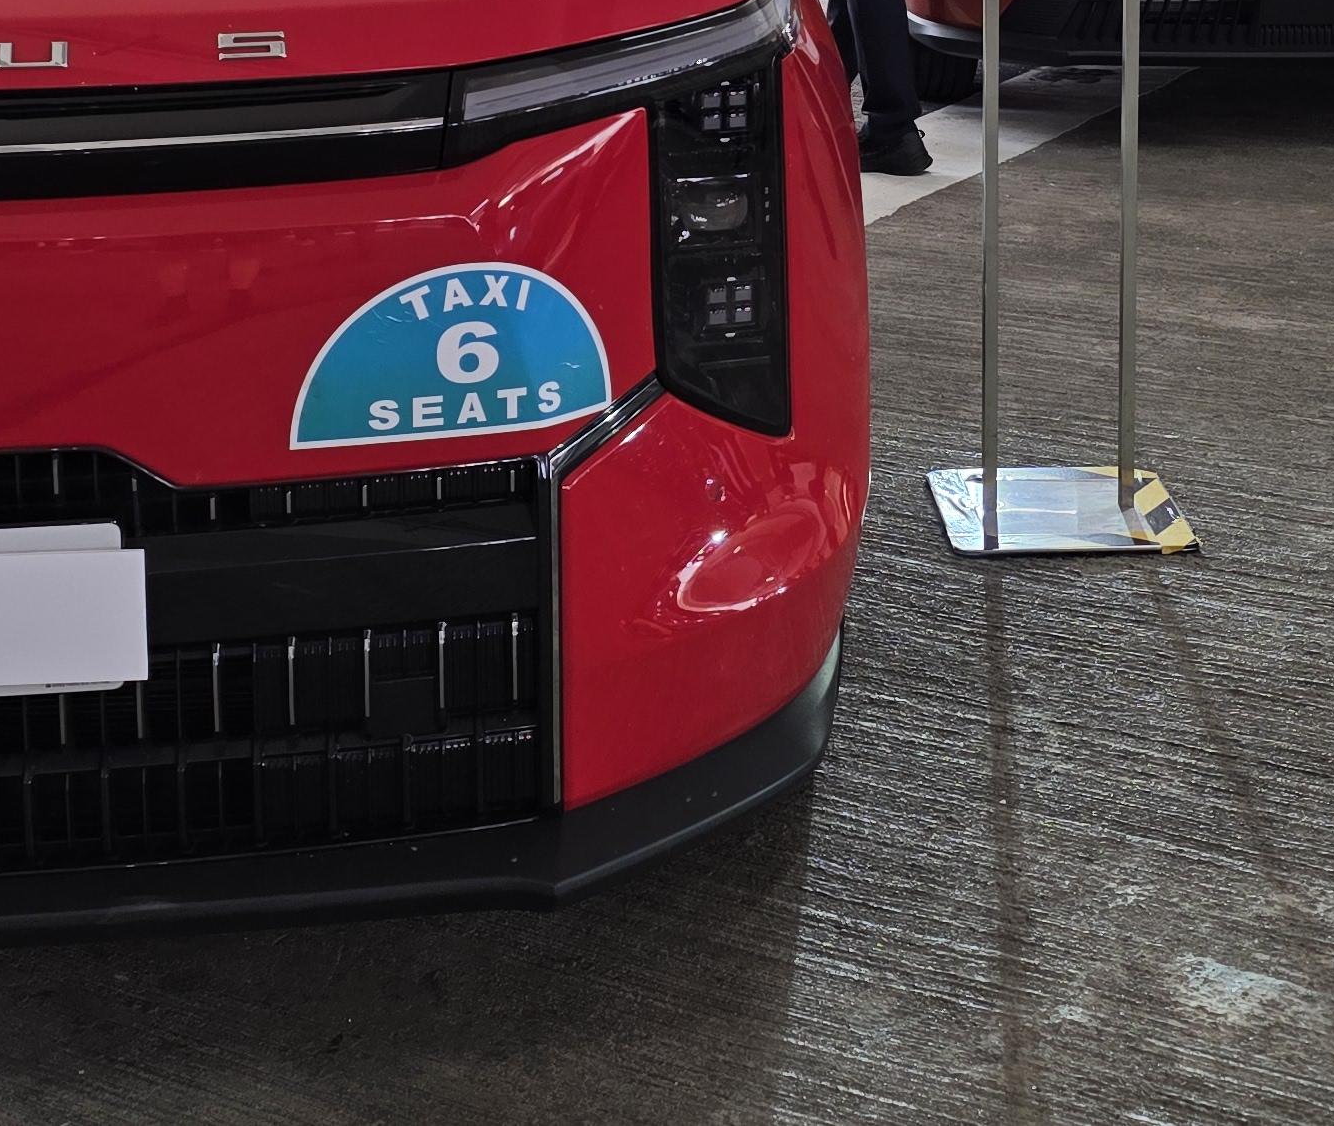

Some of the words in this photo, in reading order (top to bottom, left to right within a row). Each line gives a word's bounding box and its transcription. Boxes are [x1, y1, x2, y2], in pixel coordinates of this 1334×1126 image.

[399, 274, 531, 320] TAXI
[436, 321, 499, 384] 6
[368, 381, 562, 431] SEATS
